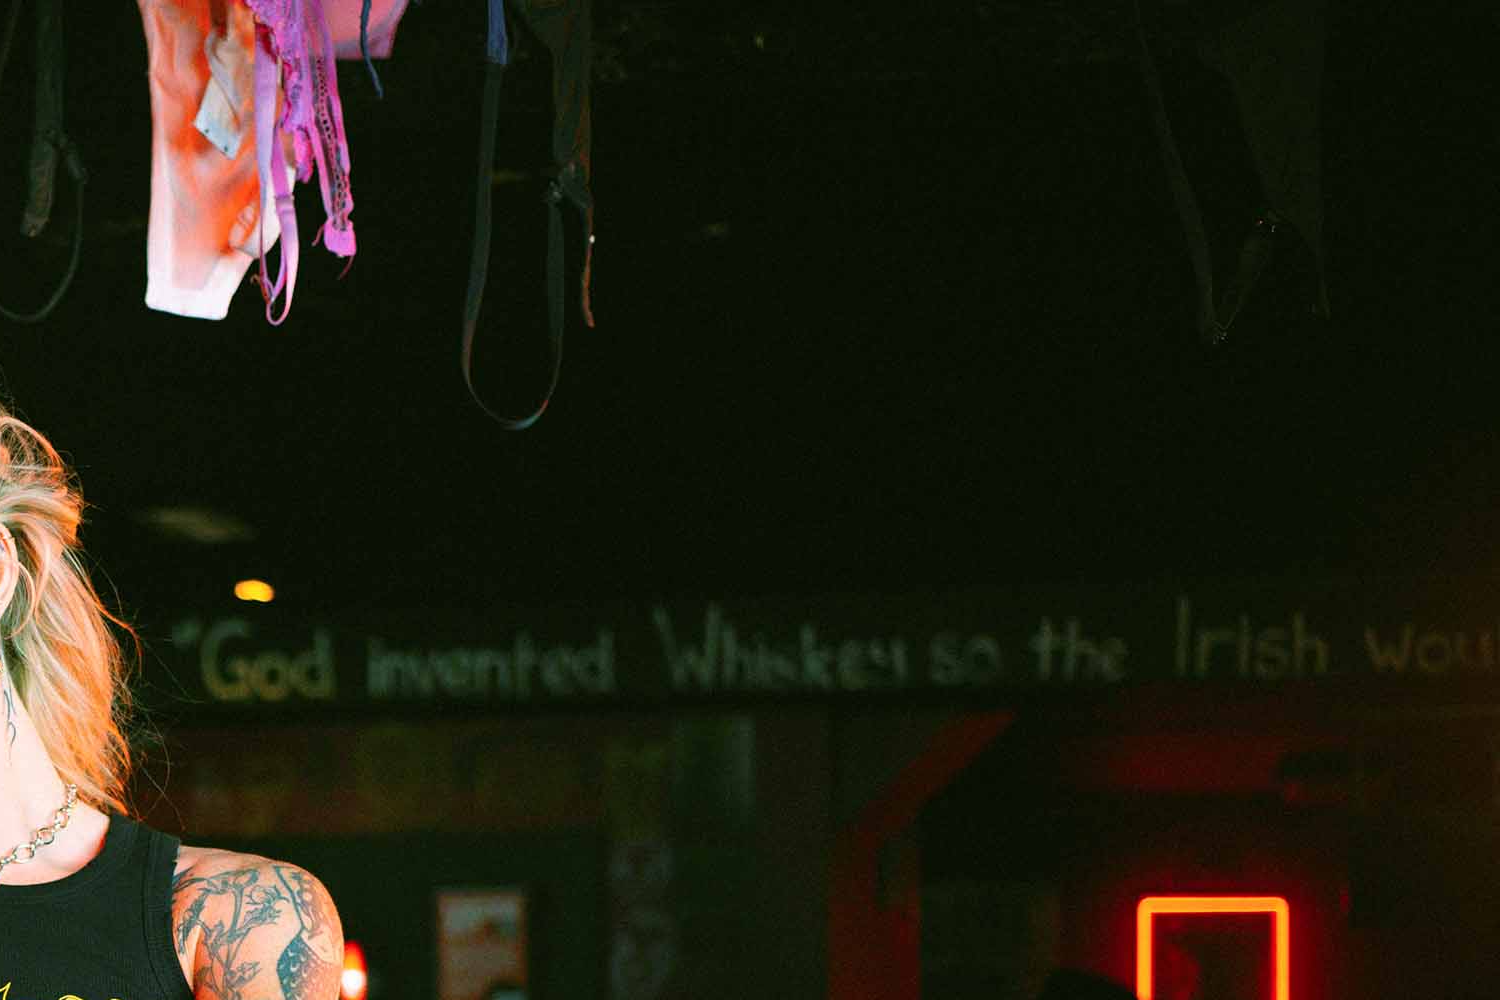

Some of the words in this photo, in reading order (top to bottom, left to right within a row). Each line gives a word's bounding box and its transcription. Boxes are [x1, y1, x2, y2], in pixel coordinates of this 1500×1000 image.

[930, 633, 1000, 685] so
[1031, 614, 1129, 681] the
[1175, 597, 1330, 678] Irish
[1364, 622, 1500, 674] wou
